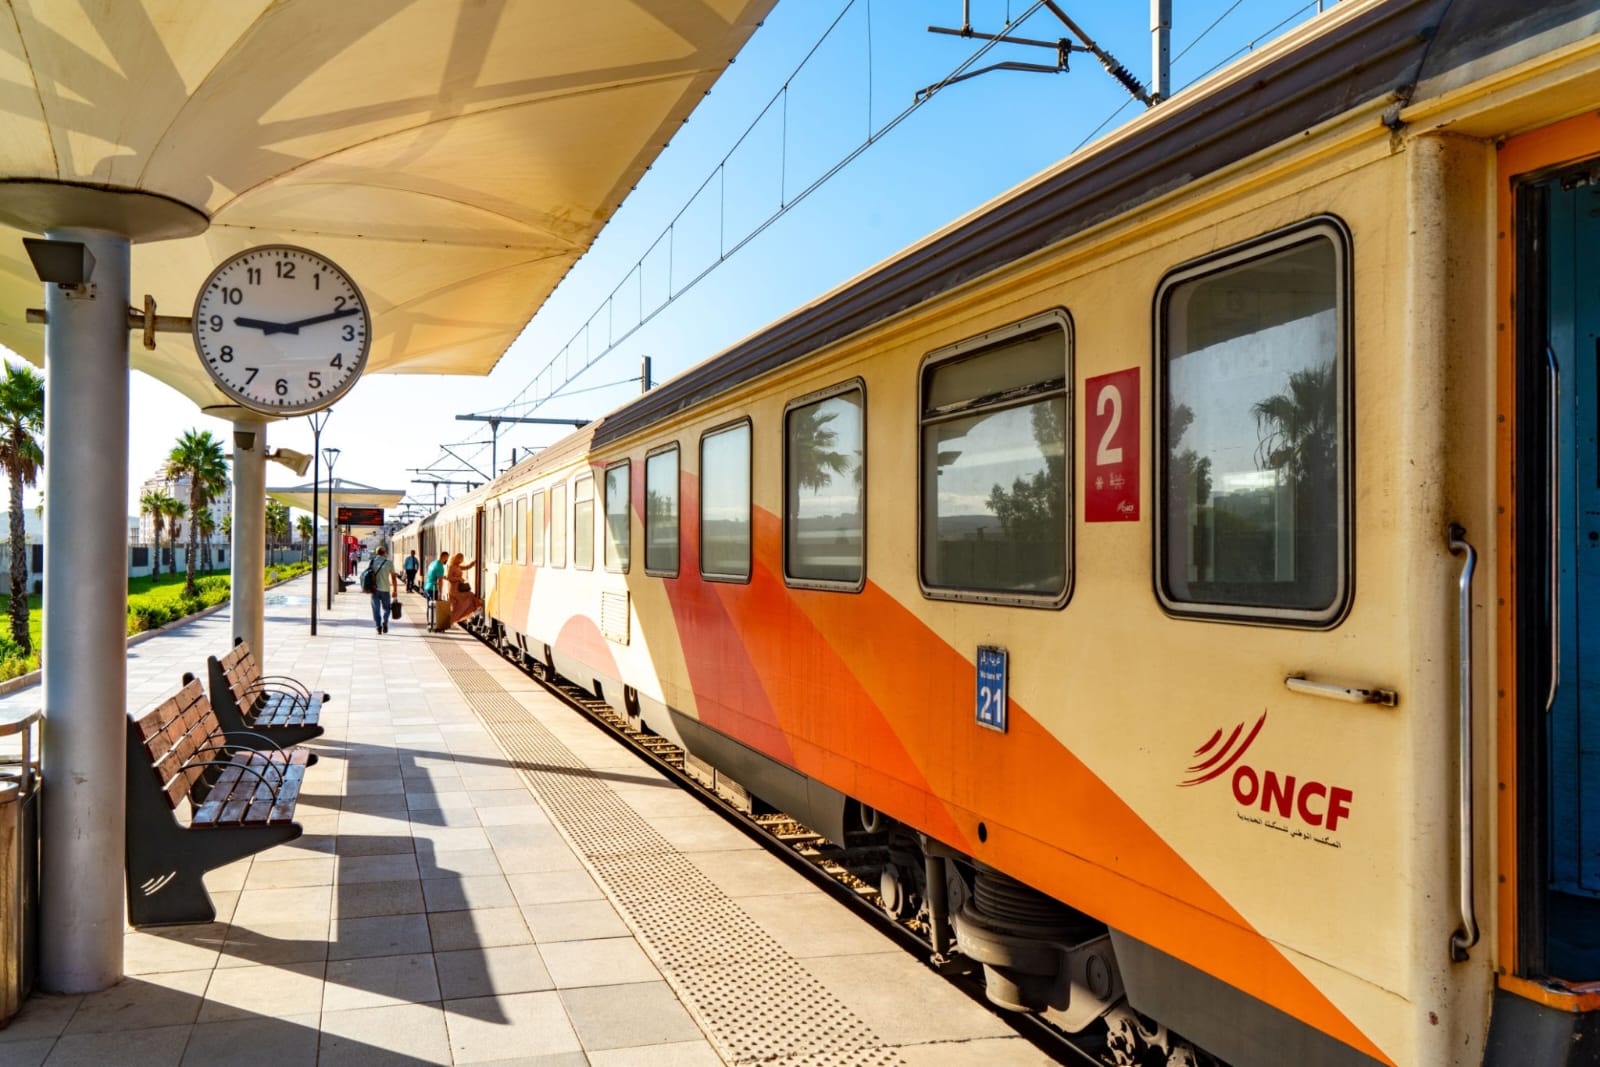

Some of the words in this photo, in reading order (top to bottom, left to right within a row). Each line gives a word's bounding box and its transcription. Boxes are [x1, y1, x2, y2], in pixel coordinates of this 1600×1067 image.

[247, 267, 262, 285] 11
[275, 261, 296, 279] 12
[313, 273, 320, 290] 1
[221, 287, 243, 305] 10
[334, 296, 347, 313] 2
[210, 315, 224, 332] 9
[341, 325, 355, 342] 3
[220, 345, 234, 363] 8
[330, 353, 343, 370] 4
[245, 367, 259, 385] 7
[308, 371, 321, 389] 5
[275, 379, 288, 396] 6
[1096, 384, 1123, 466] 2
[980, 686, 1002, 723] 21
[1232, 765, 1353, 831] ONCF
